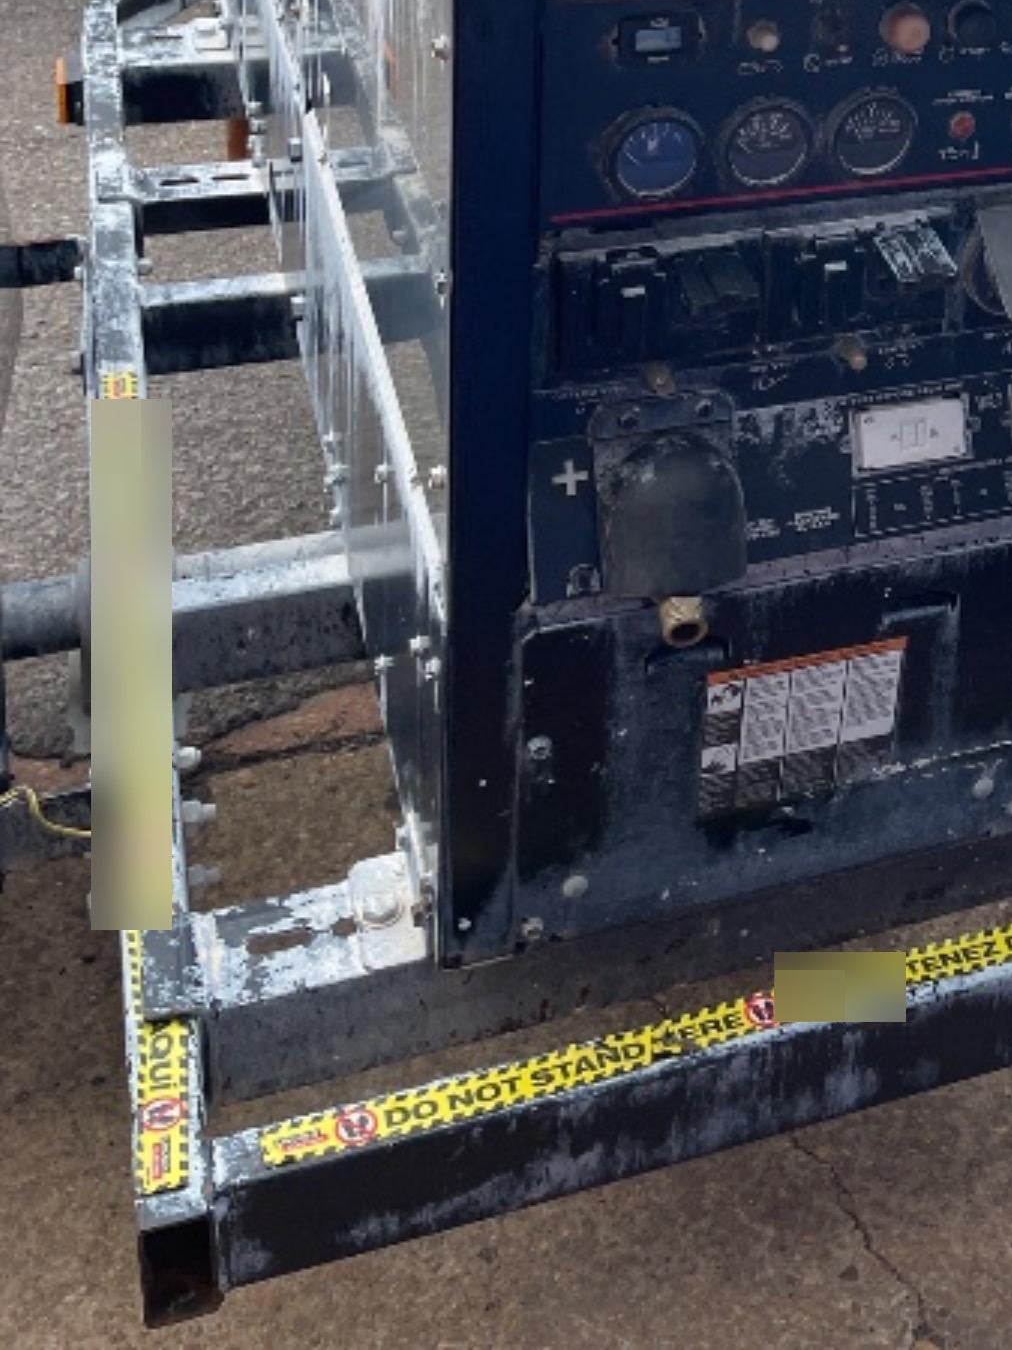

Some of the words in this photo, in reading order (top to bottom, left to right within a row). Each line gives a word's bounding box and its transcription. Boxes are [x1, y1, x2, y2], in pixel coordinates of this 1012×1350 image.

[384, 1100, 438, 1129] DO
[447, 1076, 523, 1111] NOT
[531, 1043, 646, 1087] STAND
